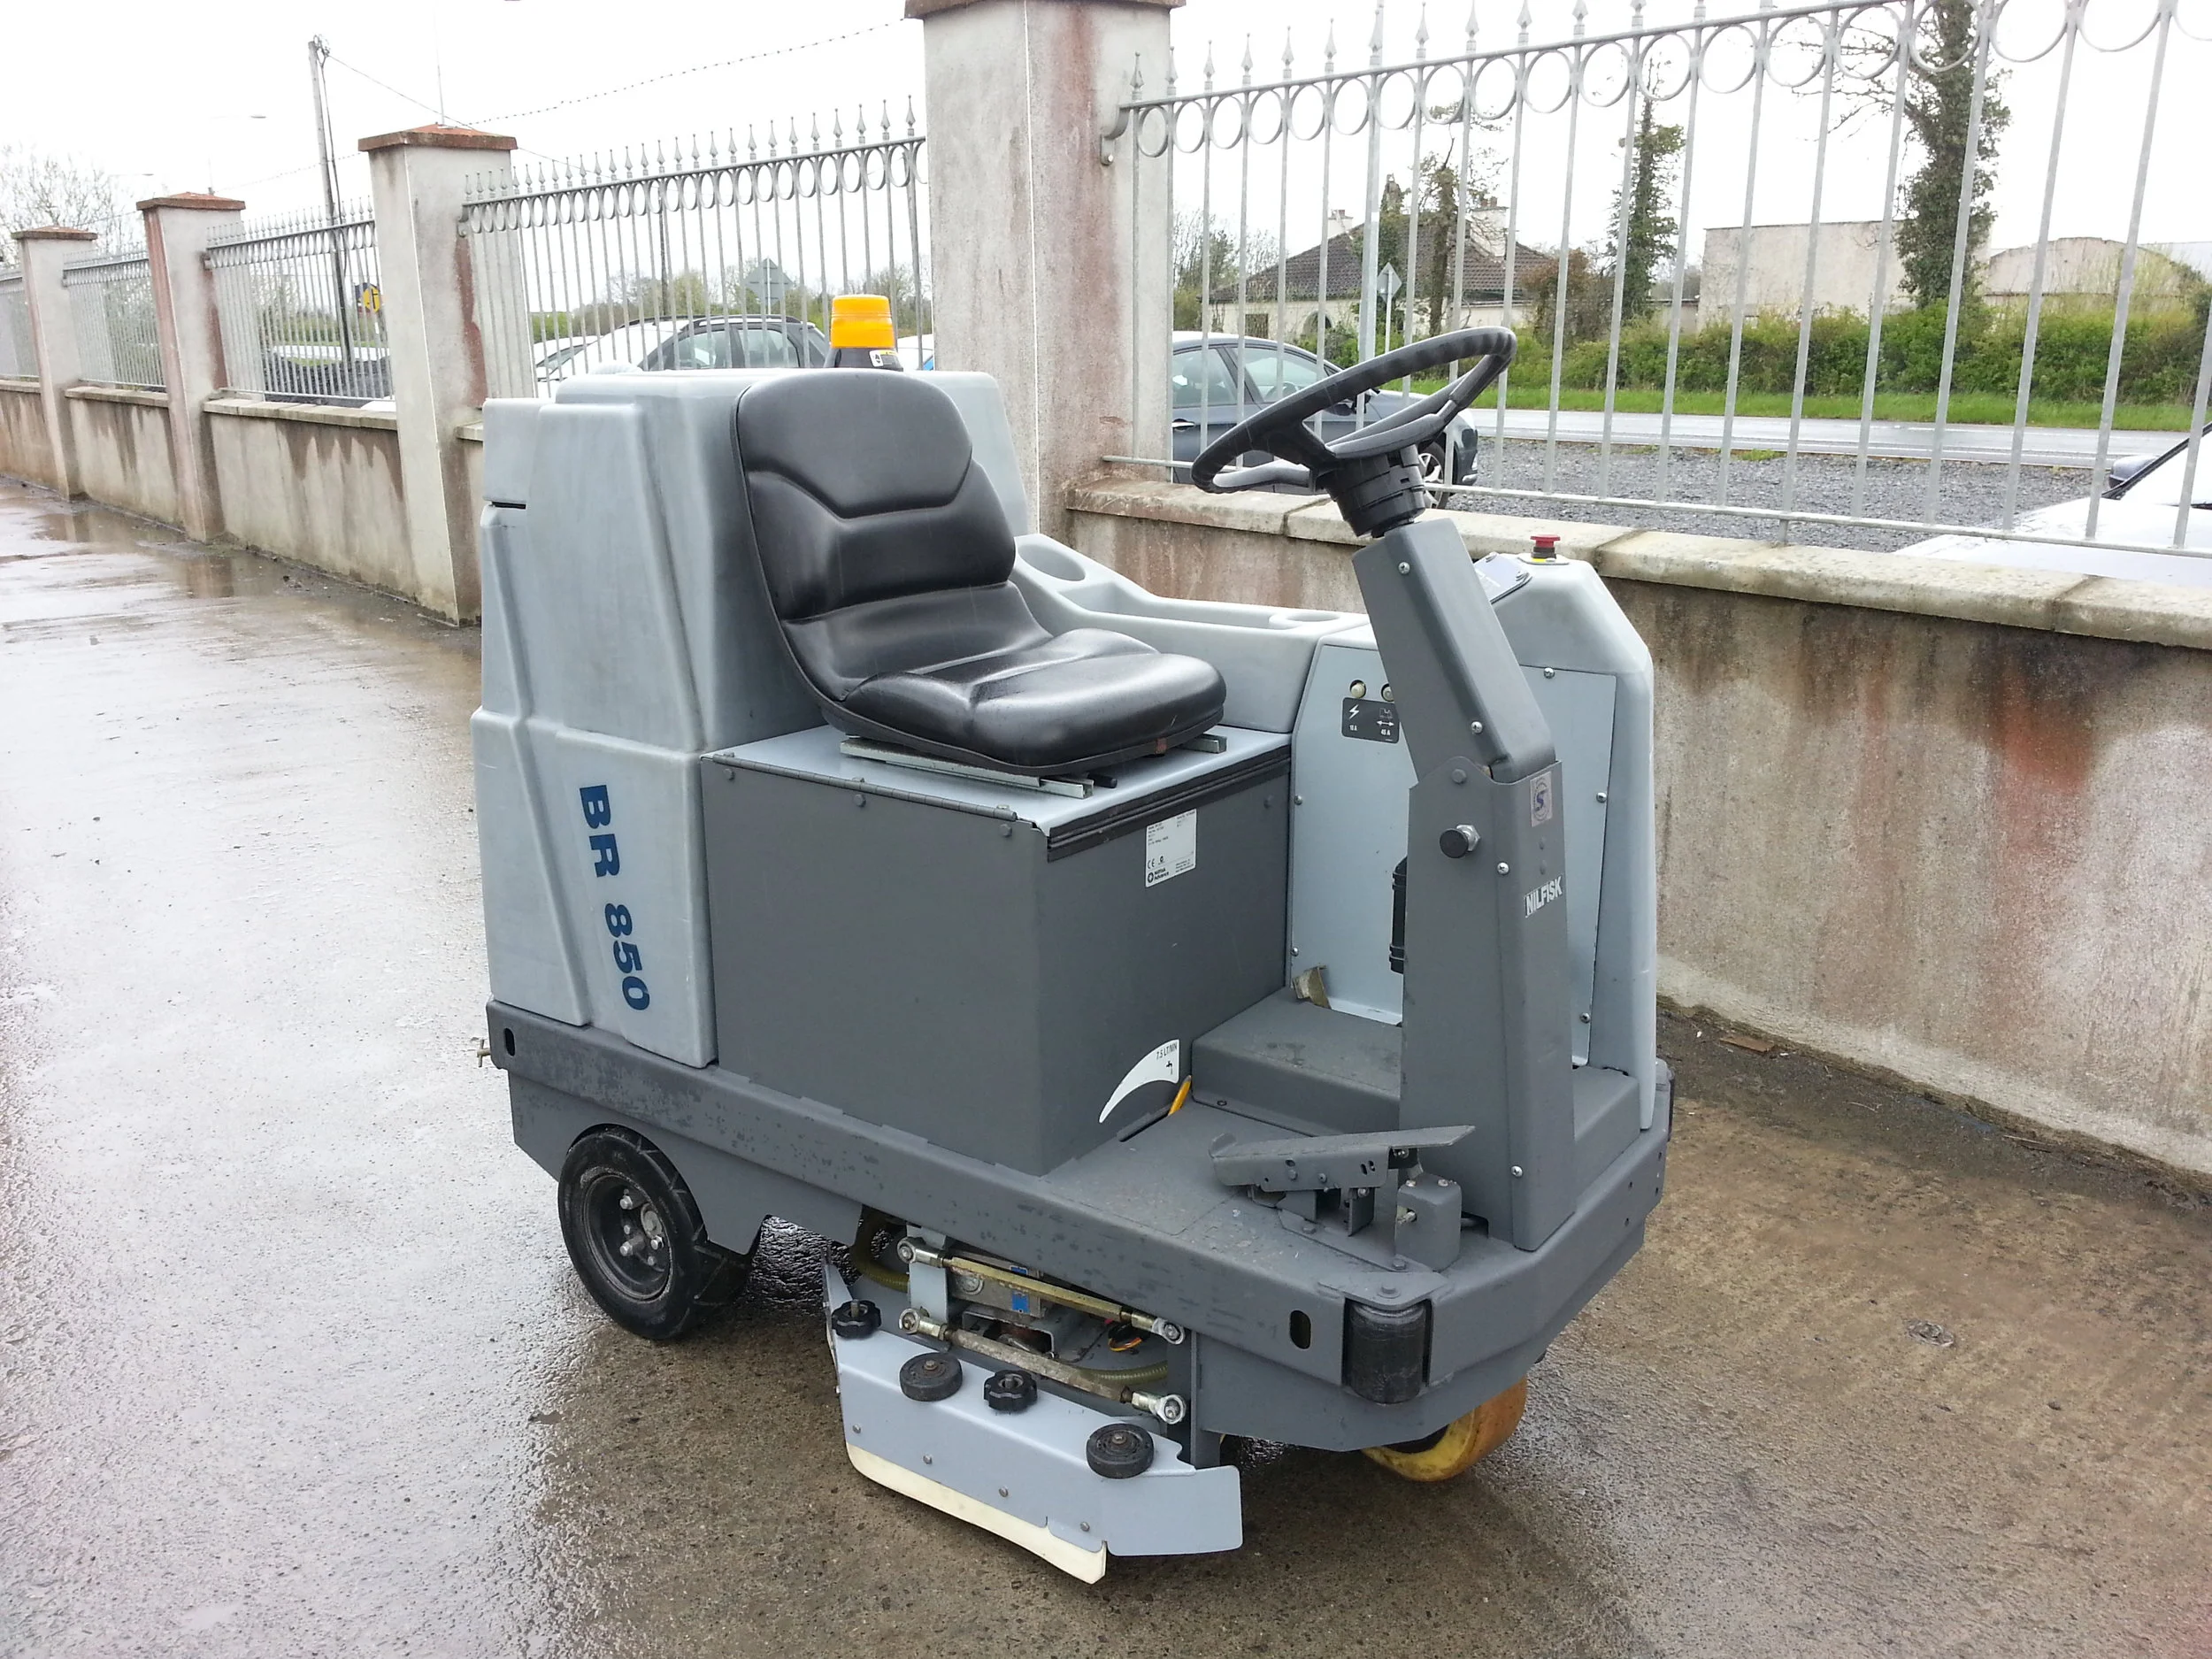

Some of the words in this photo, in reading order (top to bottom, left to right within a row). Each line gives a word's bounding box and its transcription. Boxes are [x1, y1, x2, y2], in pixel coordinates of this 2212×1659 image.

[580, 784, 620, 878] BR
[604, 902, 650, 1010] 850
[1525, 876, 1563, 917] NILFISK
